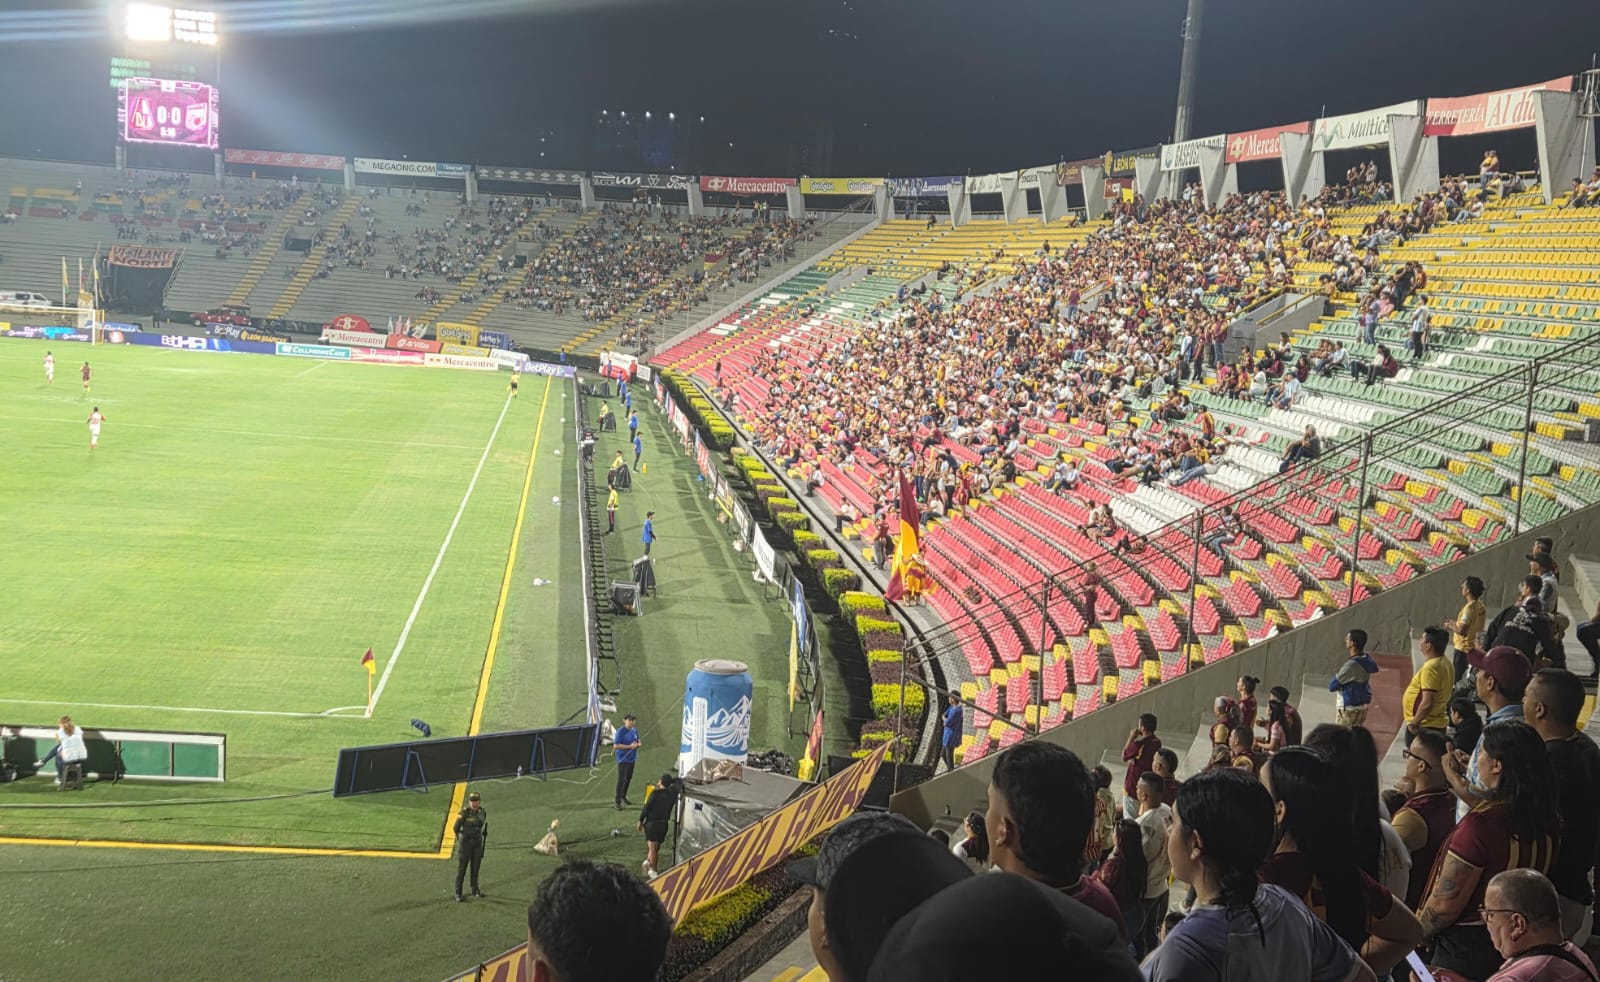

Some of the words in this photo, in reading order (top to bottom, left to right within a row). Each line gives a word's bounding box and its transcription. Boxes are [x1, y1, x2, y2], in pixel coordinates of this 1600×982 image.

[1426, 103, 1485, 125] FERRETERÍA
[1487, 95, 1512, 127] Al
[1348, 116, 1390, 140] Multice
[1247, 134, 1280, 157] Mercac
[372, 161, 436, 173] MEGAONG.COM
[726, 178, 786, 192] Mercacentro
[112, 256, 170, 267] NORTE
[338, 333, 384, 345] Mercacentro
[444, 357, 495, 368] Mercacentro
[525, 361, 557, 375] BetPlay
